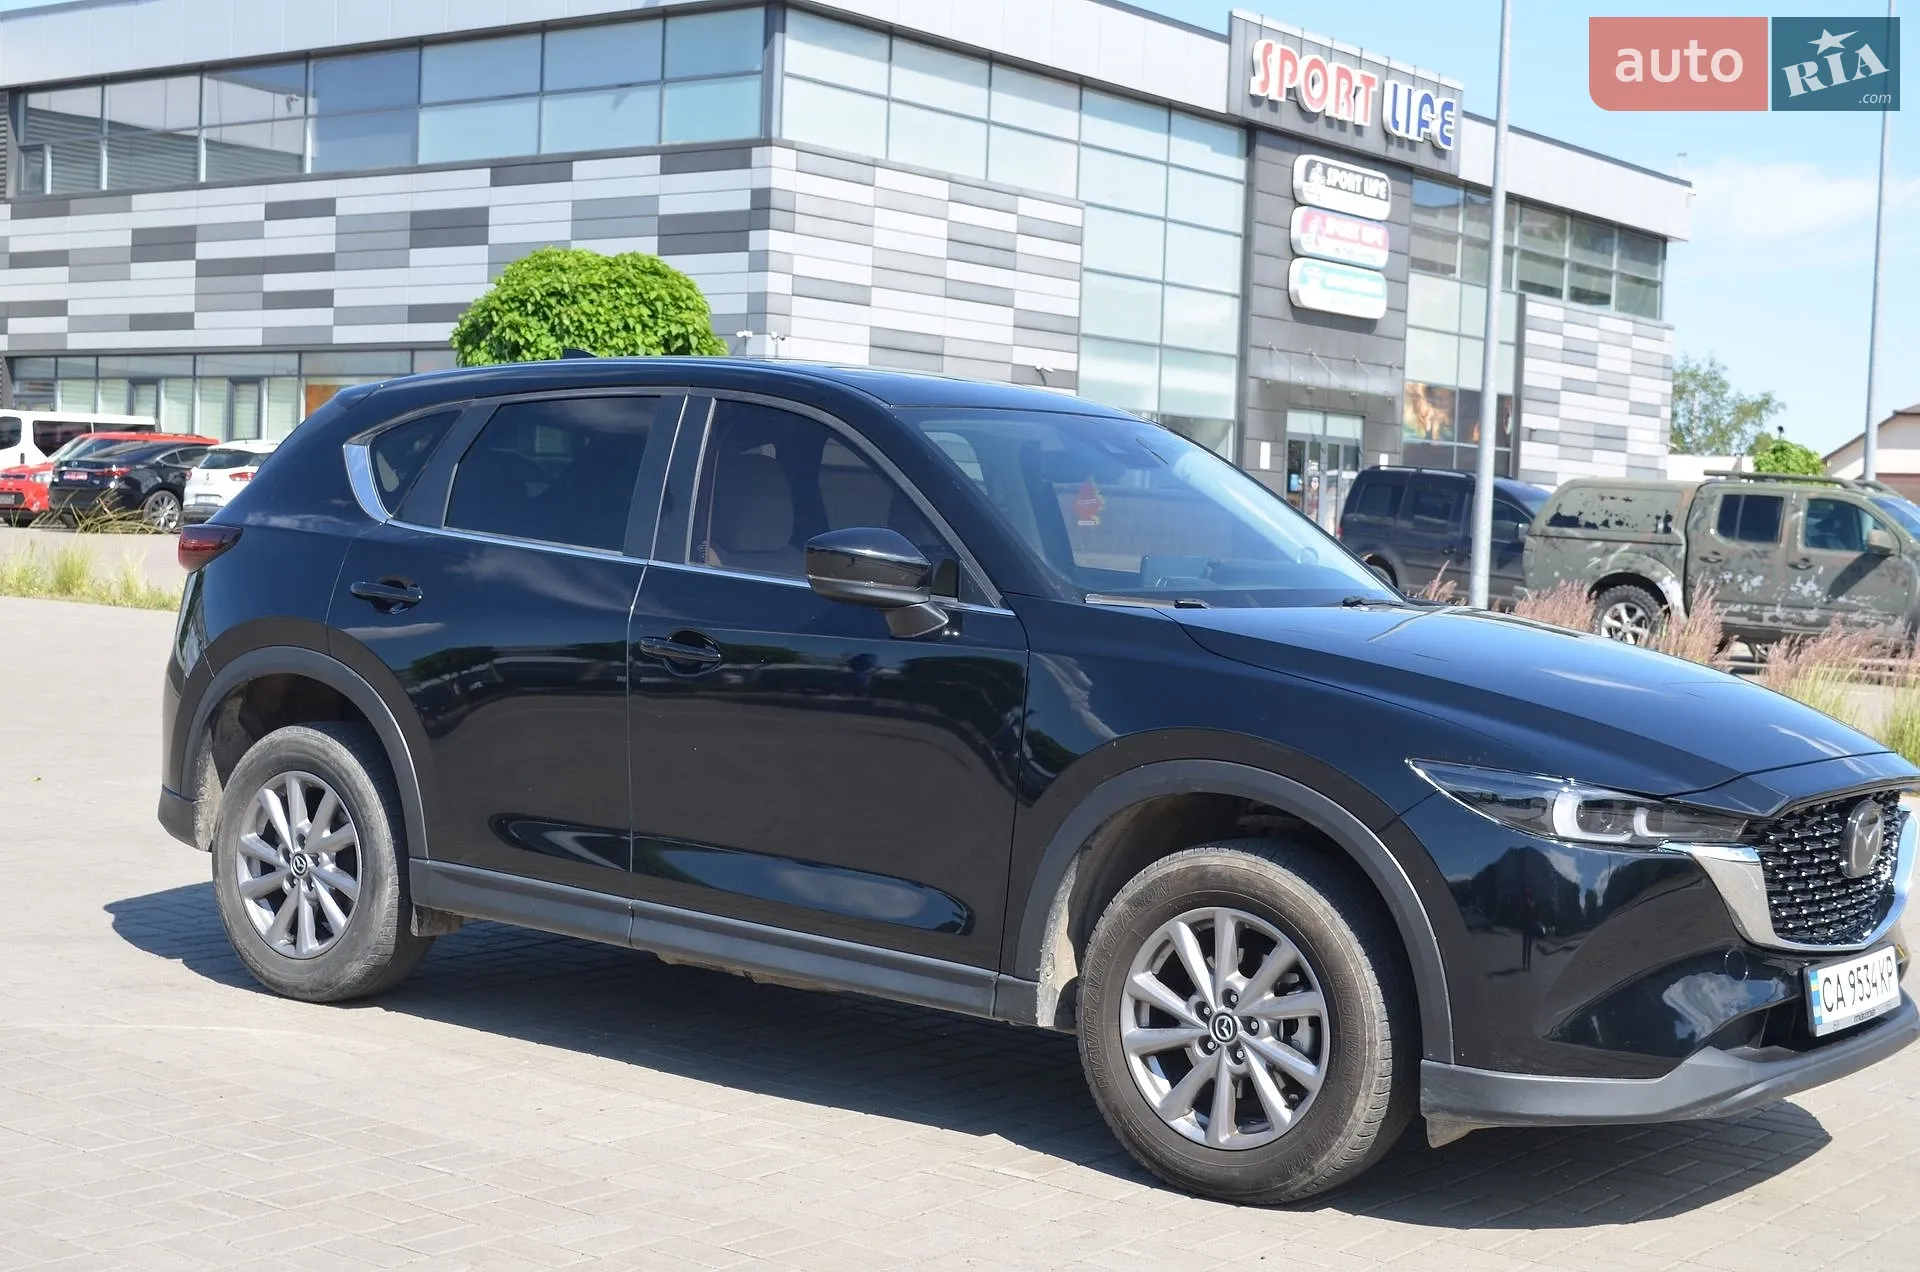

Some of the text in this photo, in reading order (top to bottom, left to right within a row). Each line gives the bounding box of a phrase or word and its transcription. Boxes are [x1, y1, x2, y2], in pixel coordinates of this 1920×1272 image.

[1250, 39, 1457, 151] SPORT LIFE
[1326, 167, 1387, 200] SPORT LIFE
[1822, 955, 1894, 1013] CA 9534 KP
